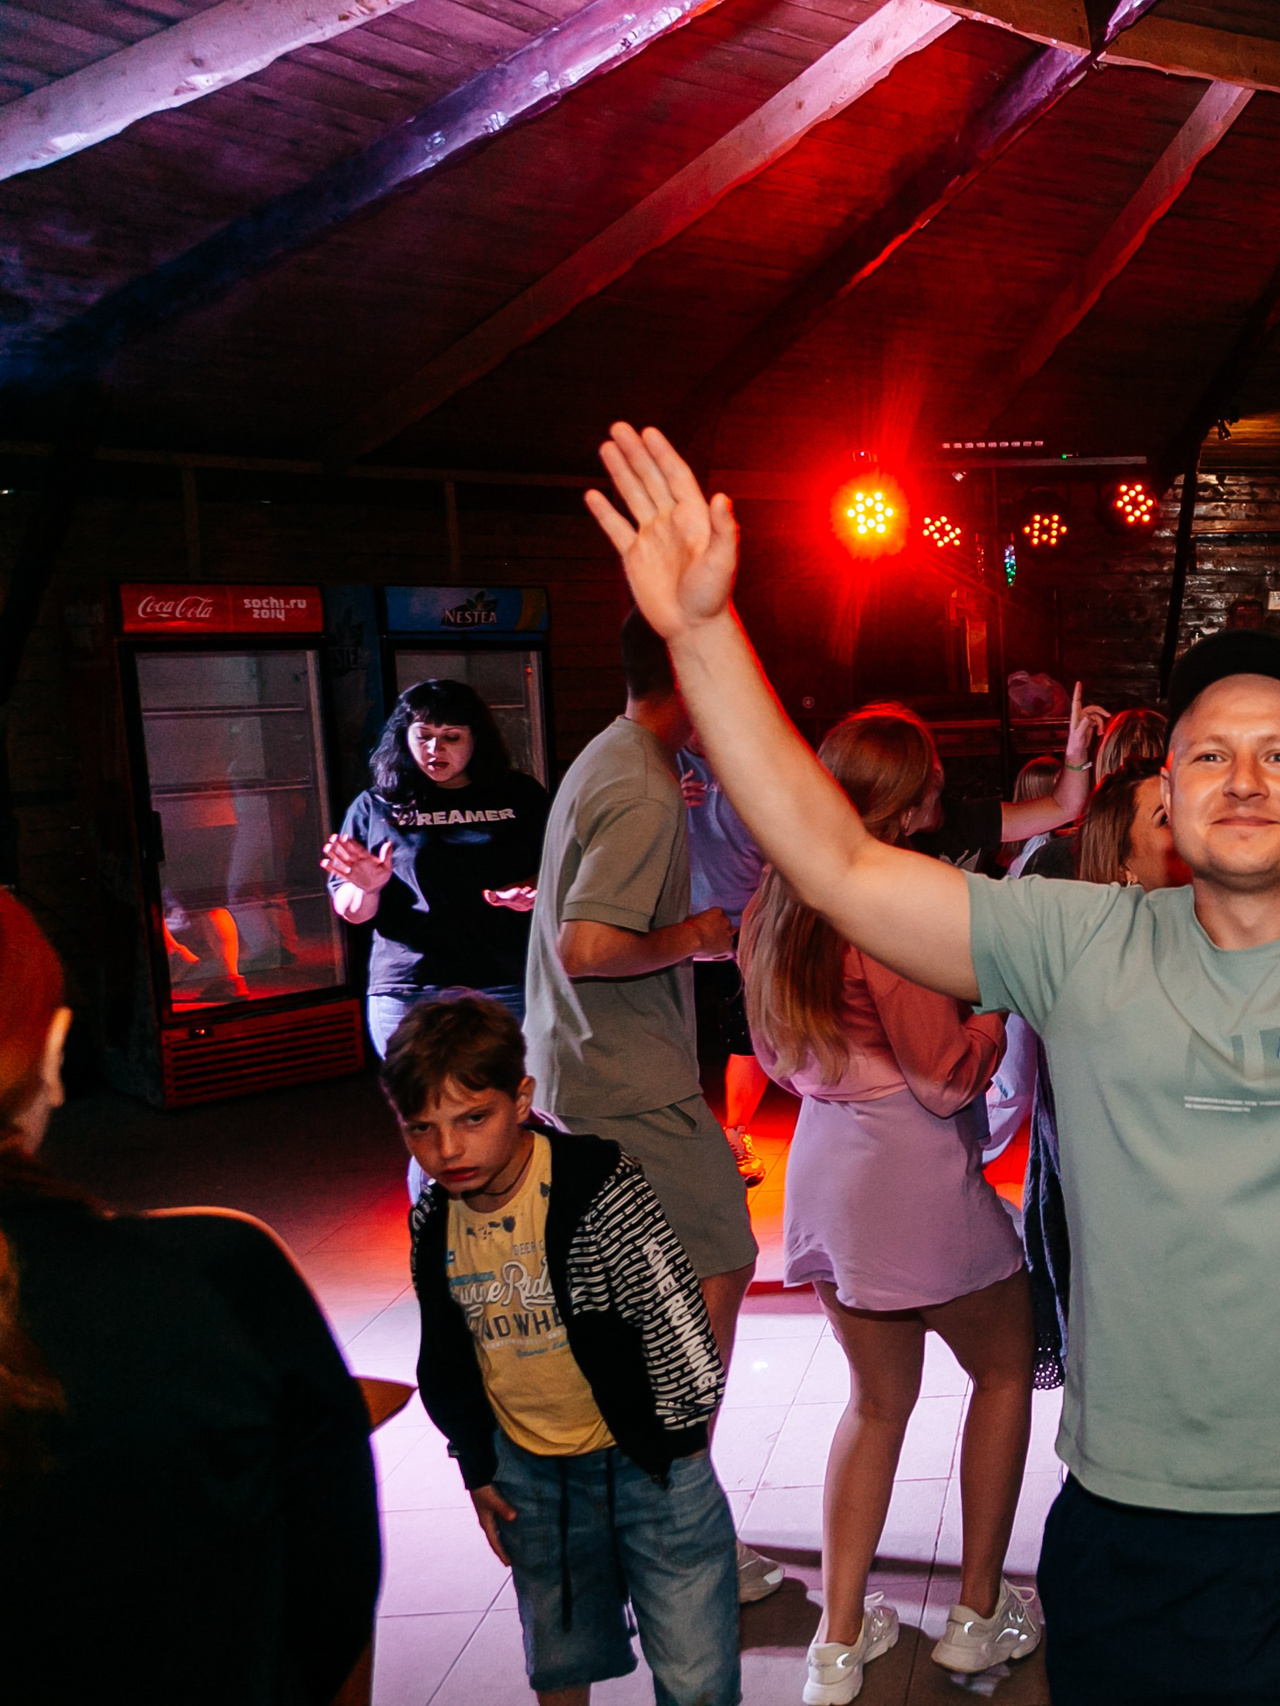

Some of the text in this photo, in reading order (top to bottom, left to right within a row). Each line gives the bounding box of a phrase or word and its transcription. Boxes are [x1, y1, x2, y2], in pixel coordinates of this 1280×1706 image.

[243, 596, 307, 609] sochi.ru
[252, 609, 286, 621] 2014
[444, 609, 498, 624] NESTEA
[665, 1291, 716, 1391] RUNNING
